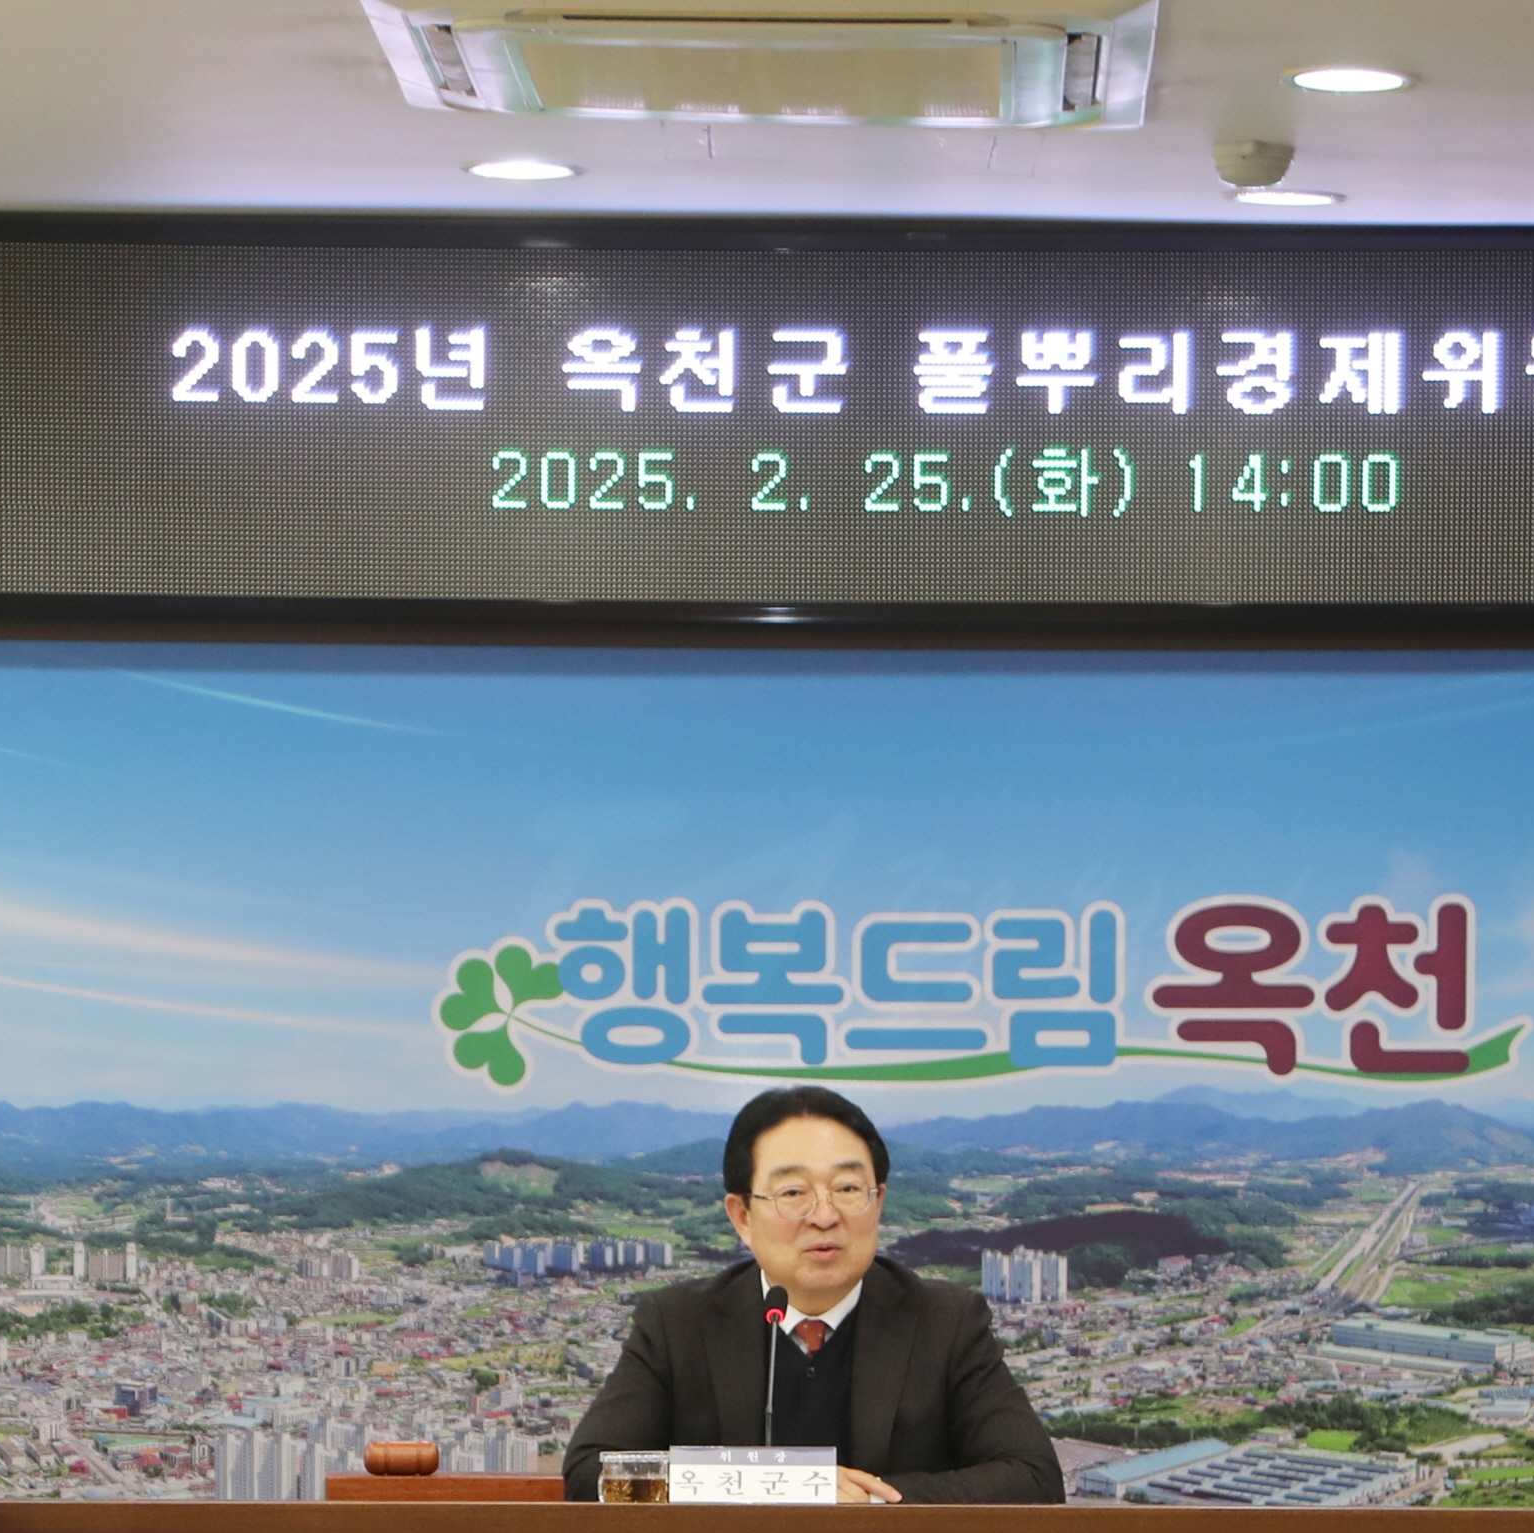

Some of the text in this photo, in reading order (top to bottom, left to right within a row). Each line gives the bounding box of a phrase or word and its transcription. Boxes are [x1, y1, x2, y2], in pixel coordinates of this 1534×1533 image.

[170, 326, 487, 412] 2025년
[561, 327, 851, 414] 옥천군
[491, 450, 697, 511] 2025.
[750, 451, 811, 512] 2.
[1188, 452, 1402, 514] 14:00
[555, 902, 1471, 1076] 행복드림 옥천
[674, 1469, 832, 1497] 옥천군수
